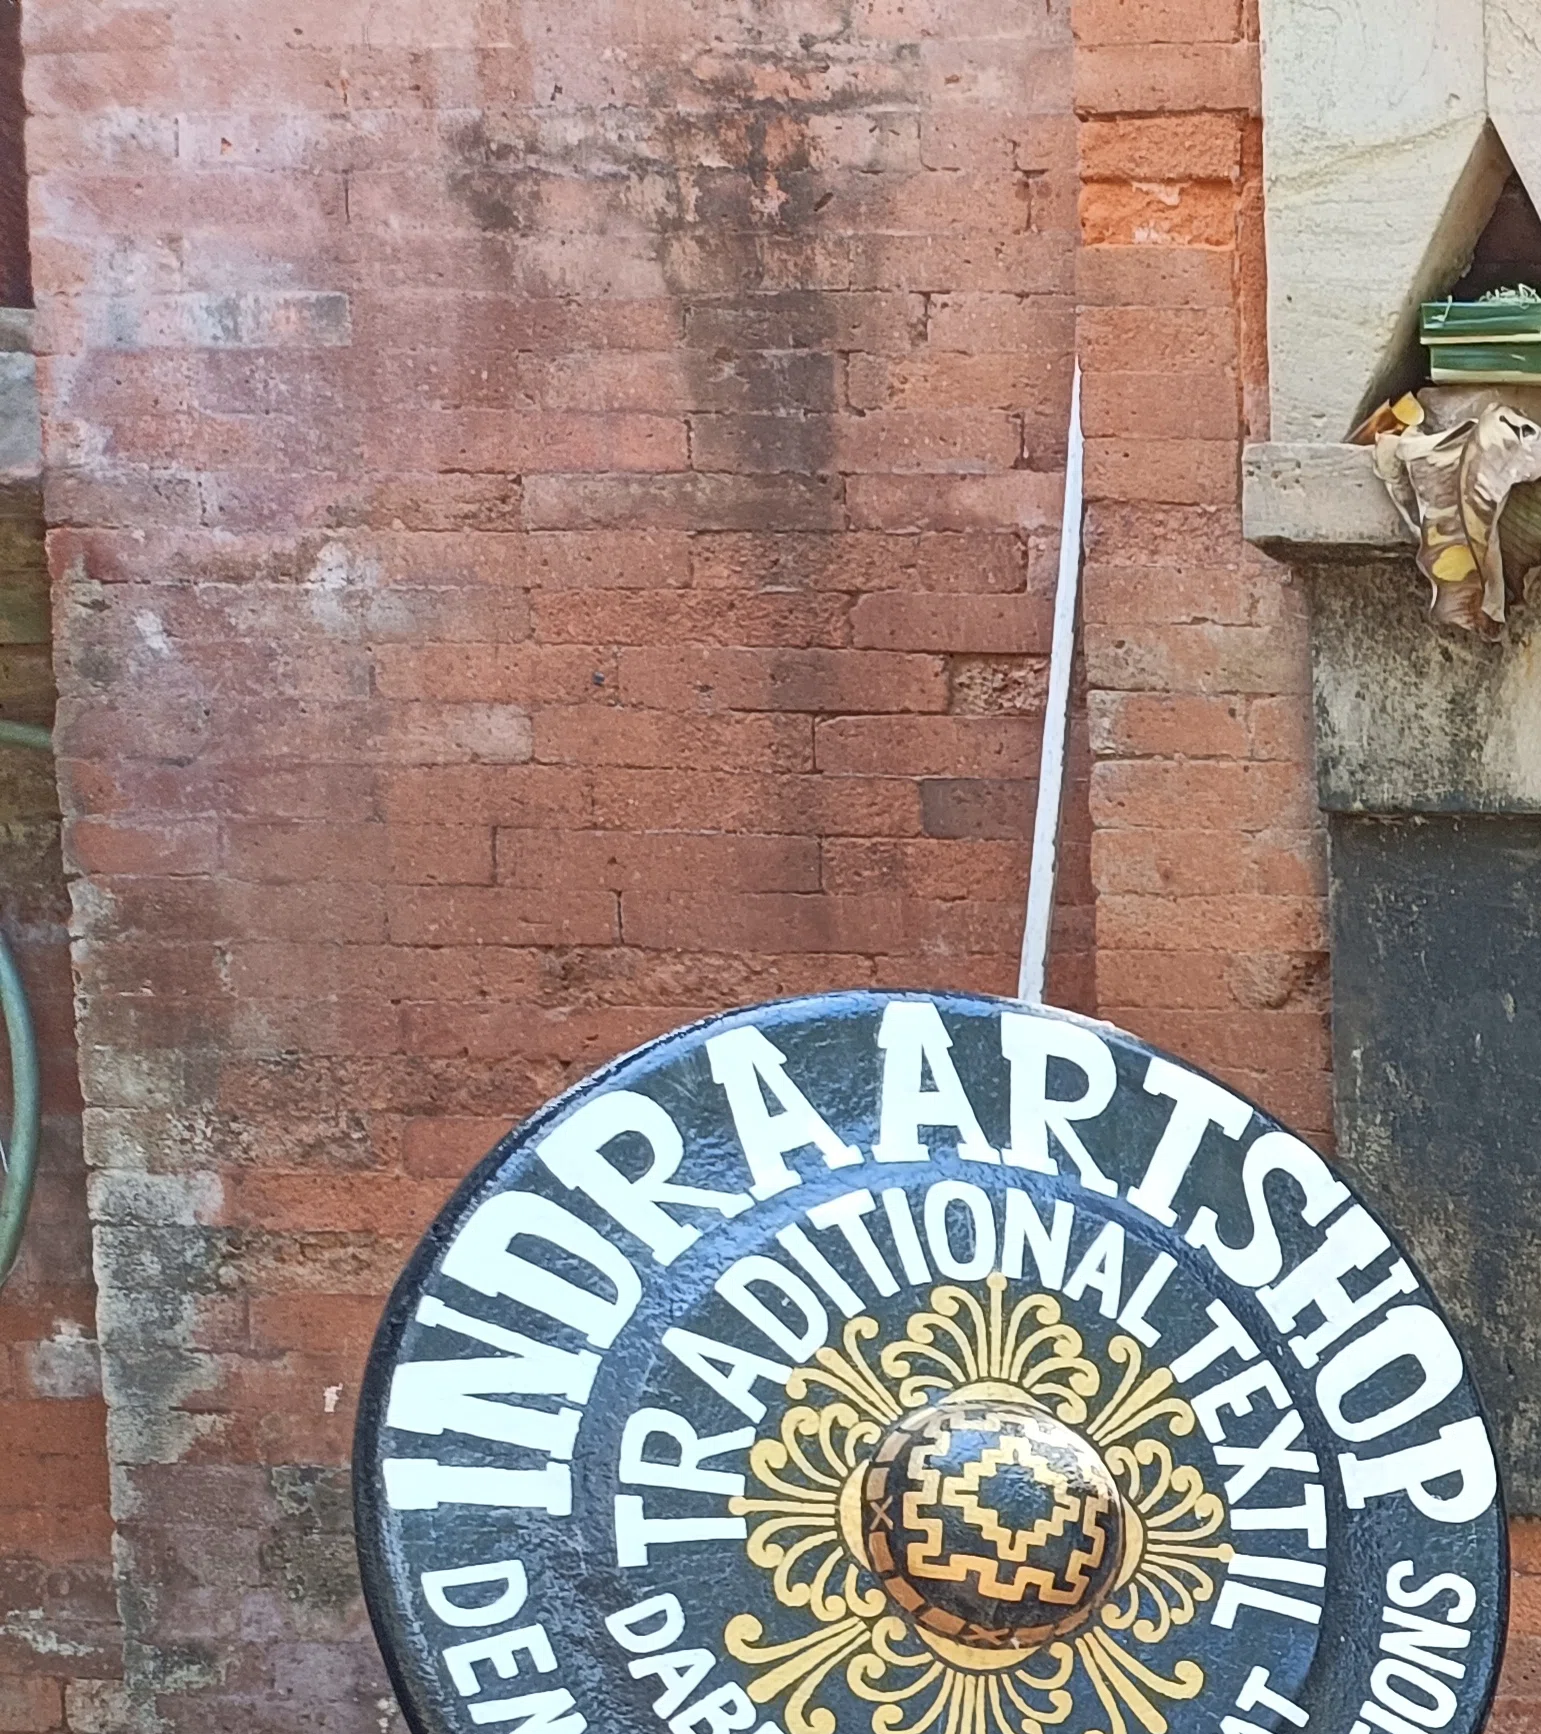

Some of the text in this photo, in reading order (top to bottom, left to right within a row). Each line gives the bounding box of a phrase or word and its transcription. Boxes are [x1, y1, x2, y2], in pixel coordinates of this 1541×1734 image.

[383, 1025, 864, 1517] INDRA
[614, 1180, 1327, 1629] TRADITIONAL TEXTIL
